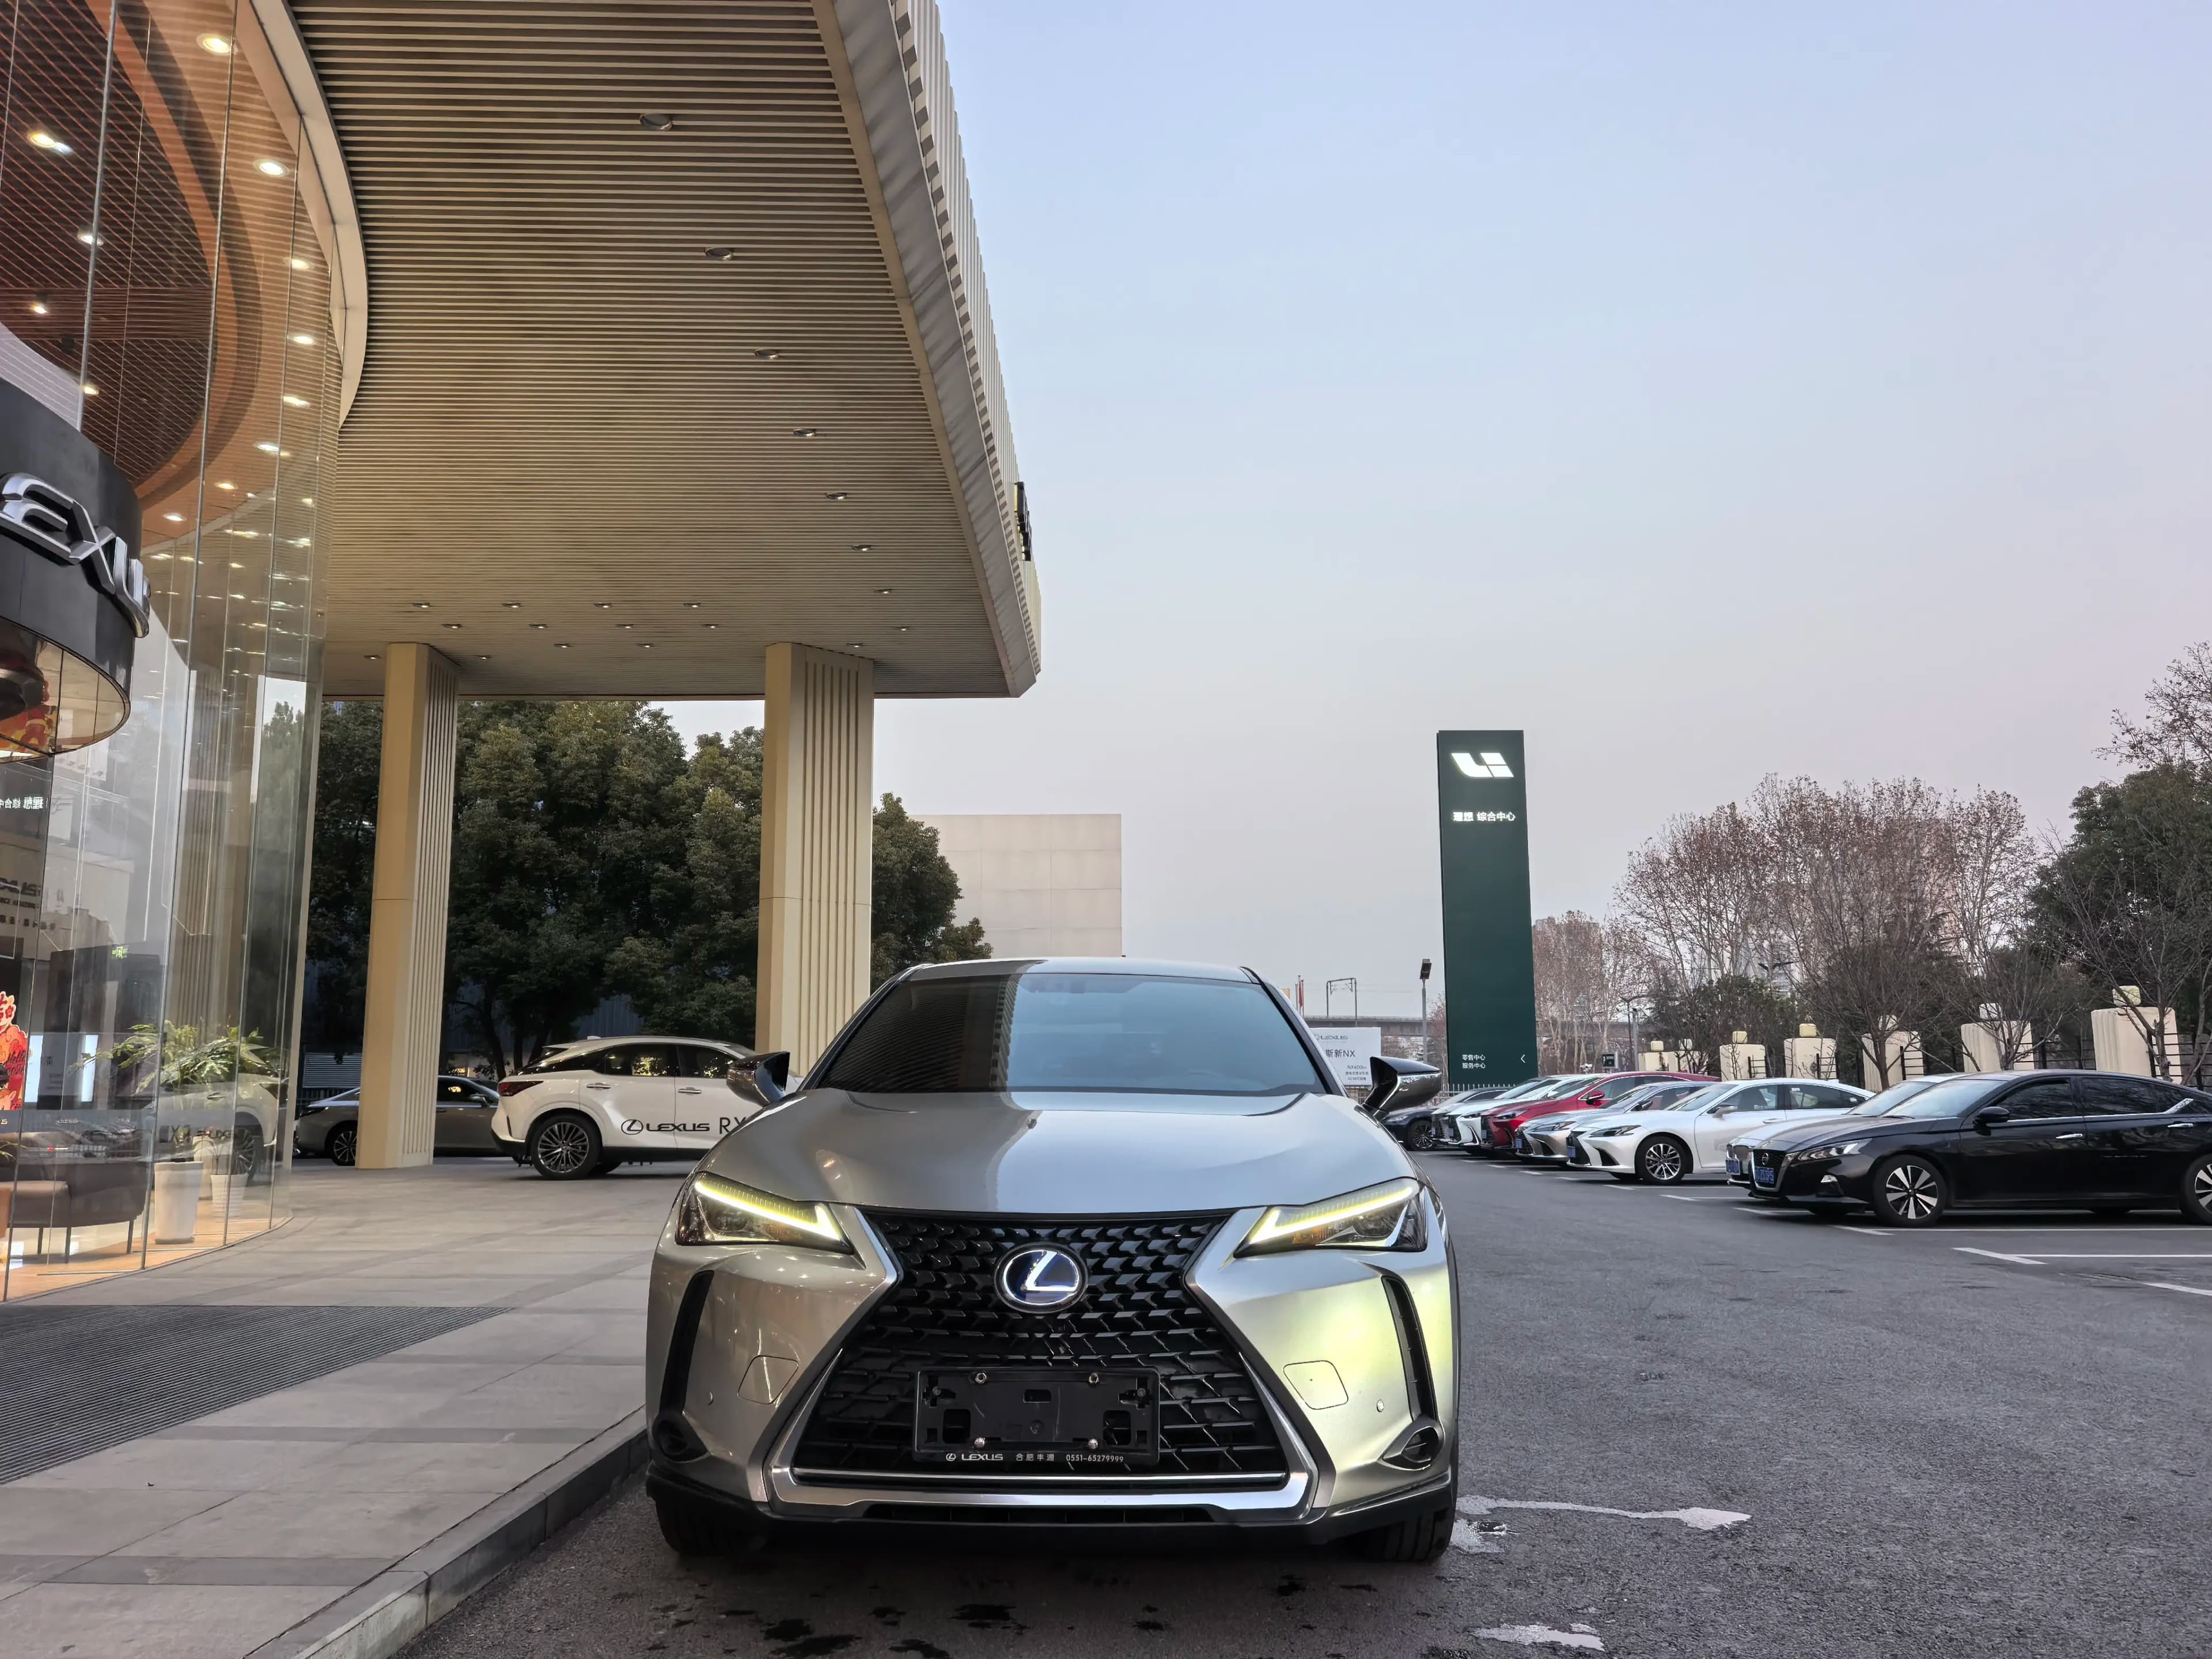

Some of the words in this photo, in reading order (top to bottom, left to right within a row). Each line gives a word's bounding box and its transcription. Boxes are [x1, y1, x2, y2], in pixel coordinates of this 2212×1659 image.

[0, 472, 151, 638] EXU
[1453, 812, 1474, 821] 理想
[1476, 811, 1516, 821] 综合中心
[646, 1123, 710, 1132] LEXUS
[961, 1453, 1003, 1461] LEXUS
[1066, 1454, 1124, 1463] 0551-65279999
